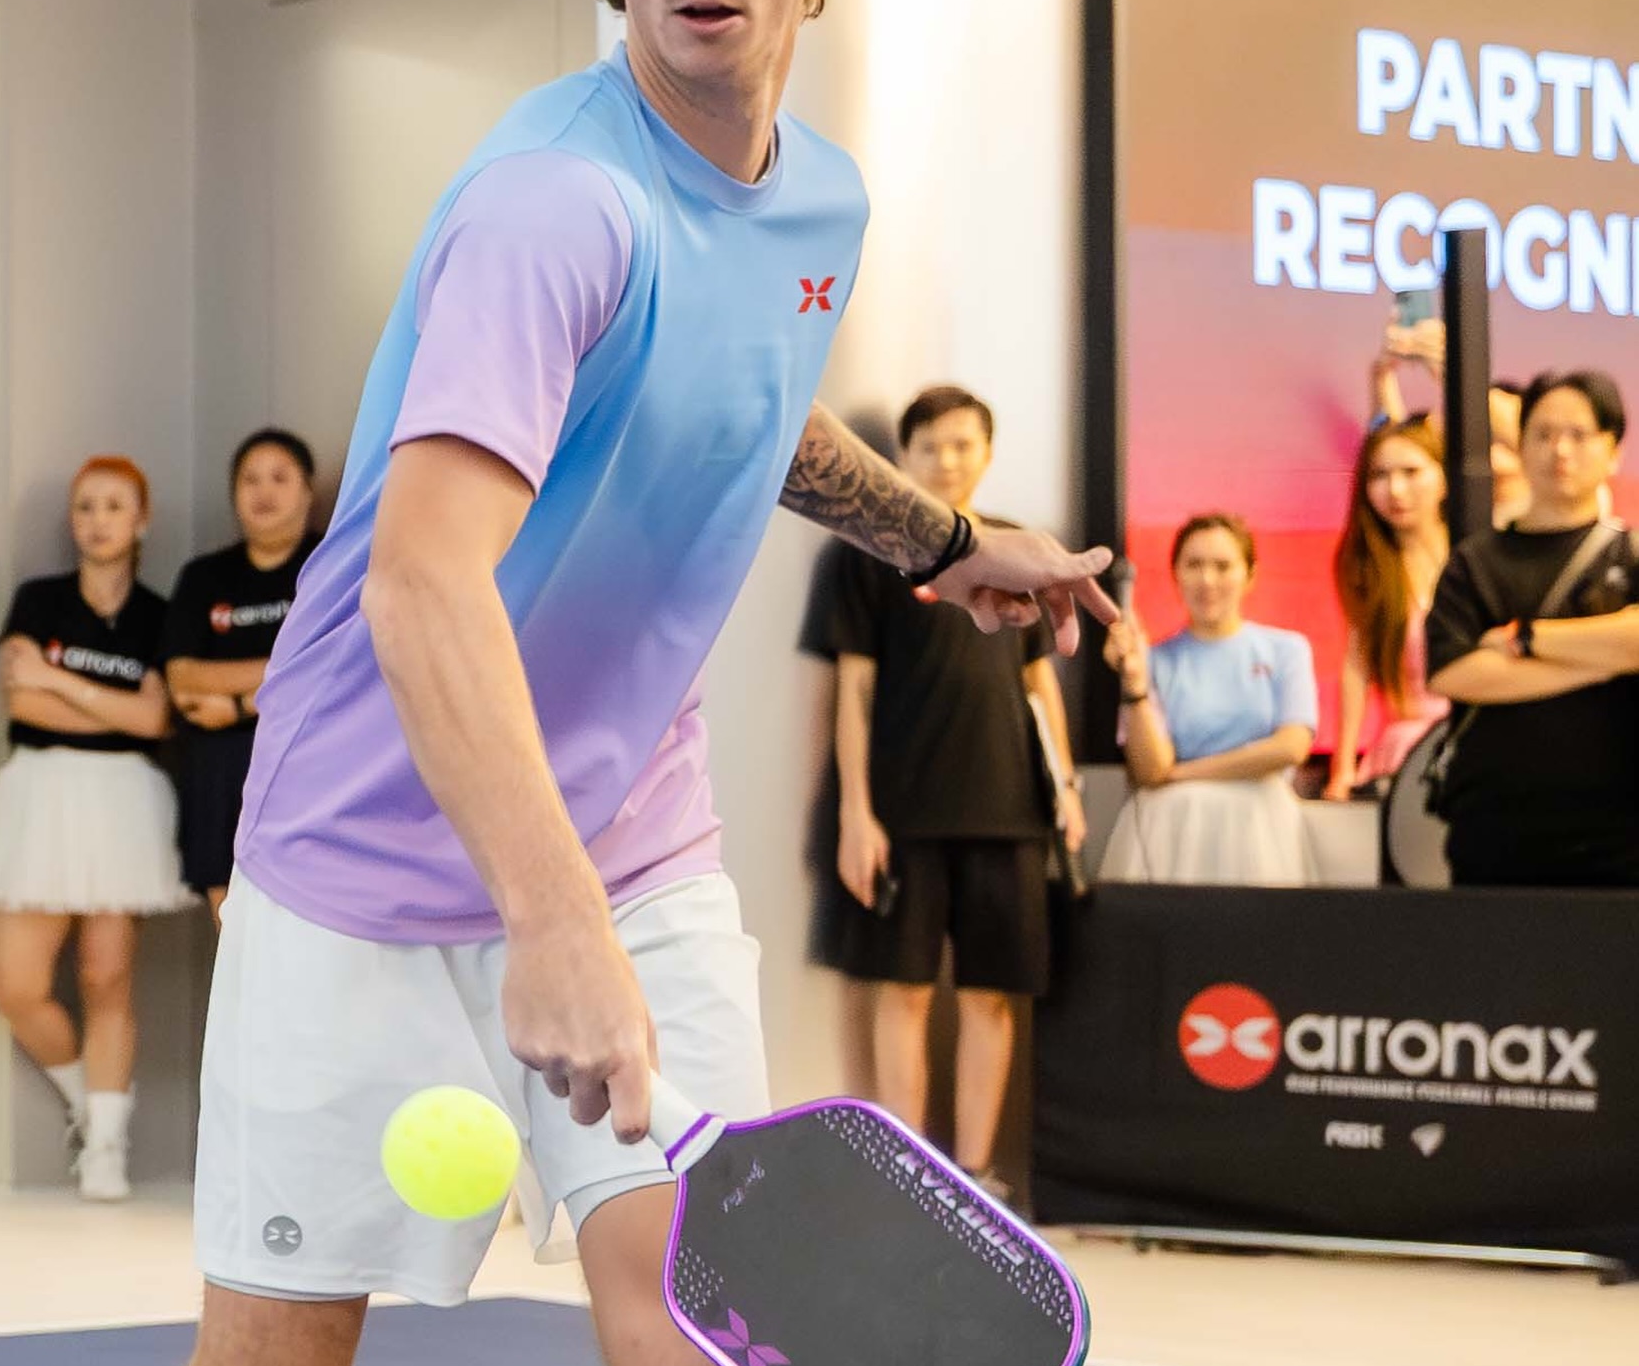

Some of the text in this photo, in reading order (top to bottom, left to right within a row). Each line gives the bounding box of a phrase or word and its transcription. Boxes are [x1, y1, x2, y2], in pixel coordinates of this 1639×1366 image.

[1356, 28, 1639, 165] PARTN
[1252, 177, 1639, 317] RECOGN
[1284, 1013, 1598, 1086] arronax
